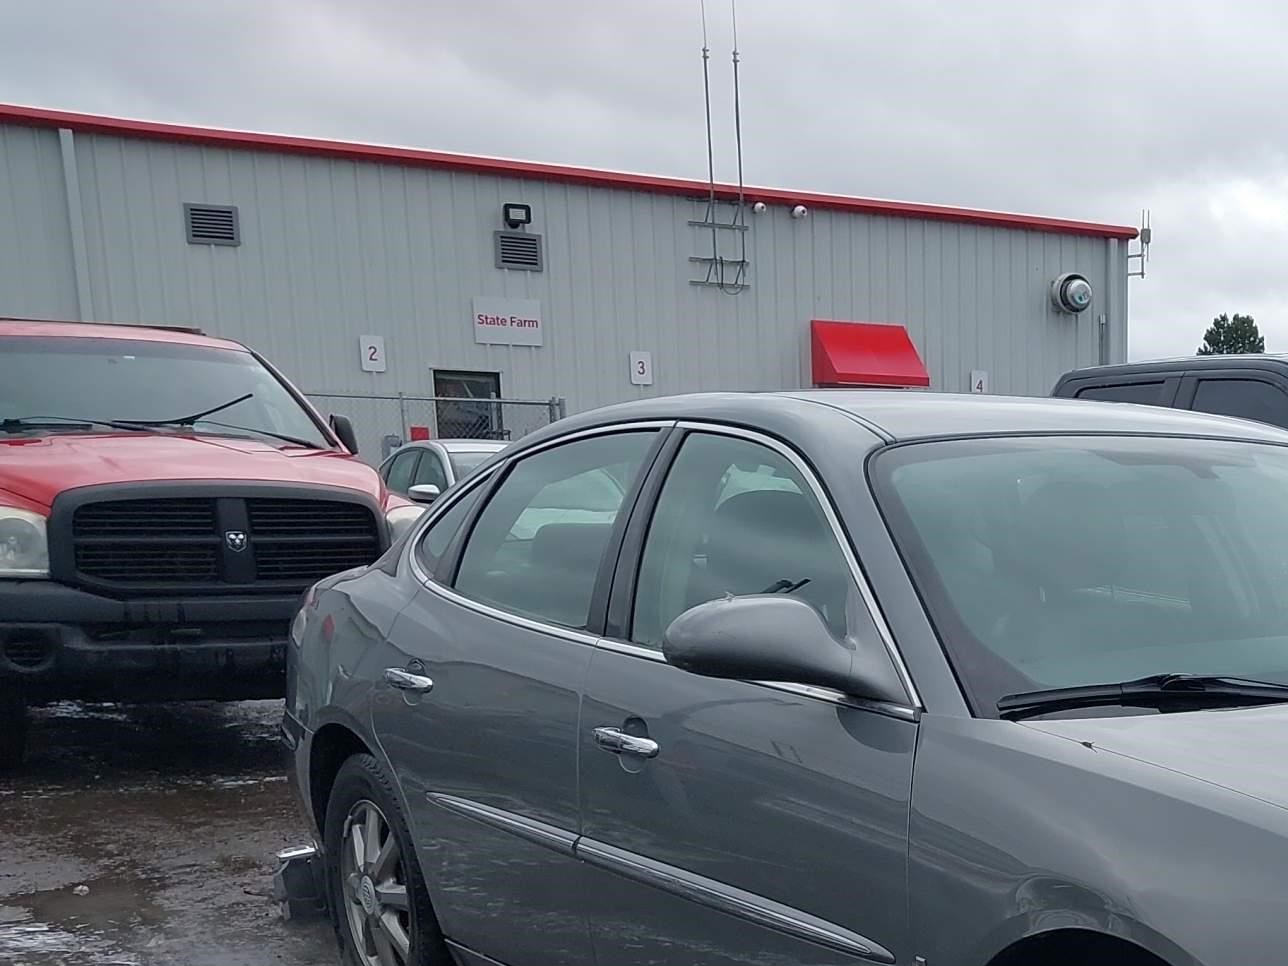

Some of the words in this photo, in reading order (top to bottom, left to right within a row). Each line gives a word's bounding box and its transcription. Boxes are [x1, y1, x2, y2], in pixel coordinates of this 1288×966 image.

[477, 314, 508, 327] State
[510, 316, 539, 329] Farm
[368, 345, 379, 361] 2
[637, 360, 646, 375] 3
[976, 379, 983, 393] 4
